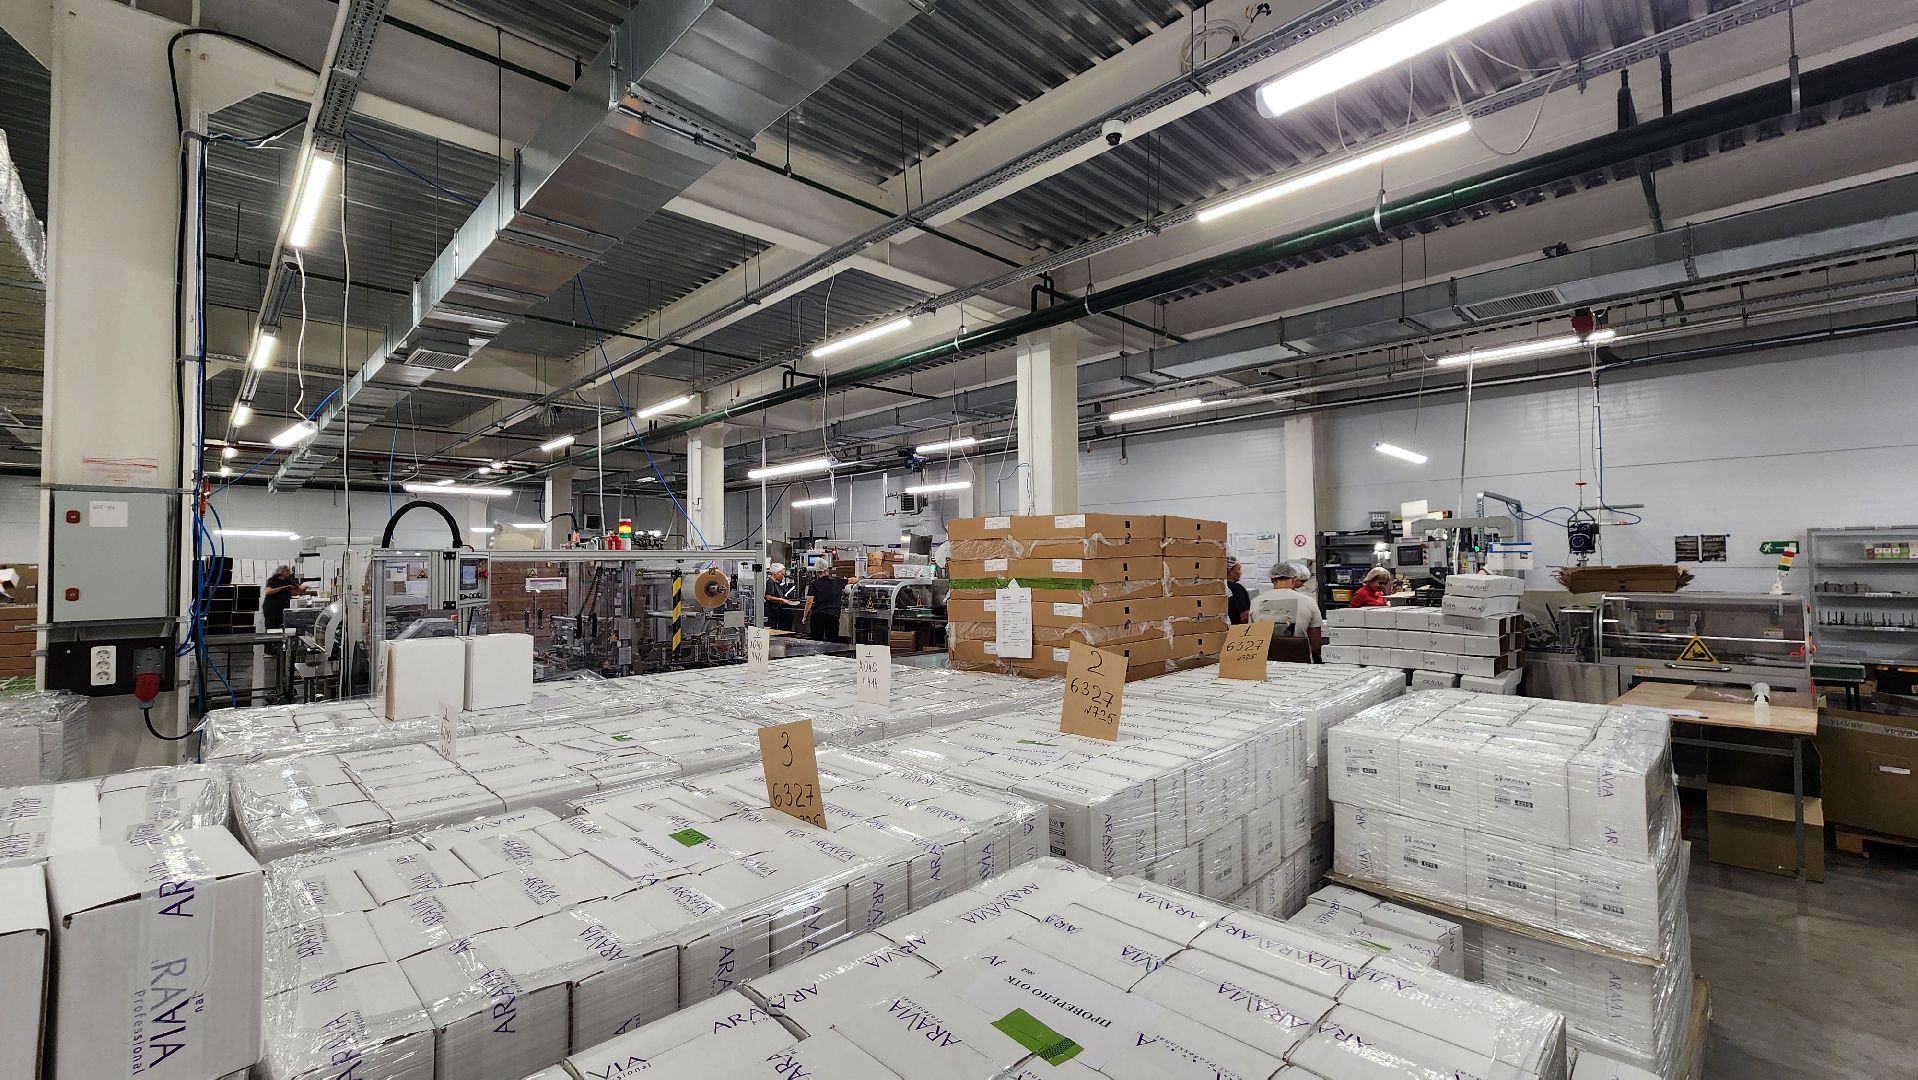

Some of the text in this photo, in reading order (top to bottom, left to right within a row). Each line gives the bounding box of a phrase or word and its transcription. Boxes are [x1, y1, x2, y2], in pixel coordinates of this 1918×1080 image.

[1226, 639, 1265, 651] 6327
[1086, 650, 1105, 677] 2
[1070, 677, 1114, 708] 6327
[781, 731, 793, 767] 3
[772, 782, 815, 808] 6327
[1003, 975, 1113, 1029] ПРОВЕРЕНО ОТК
[888, 999, 964, 1048] ARAVIA
